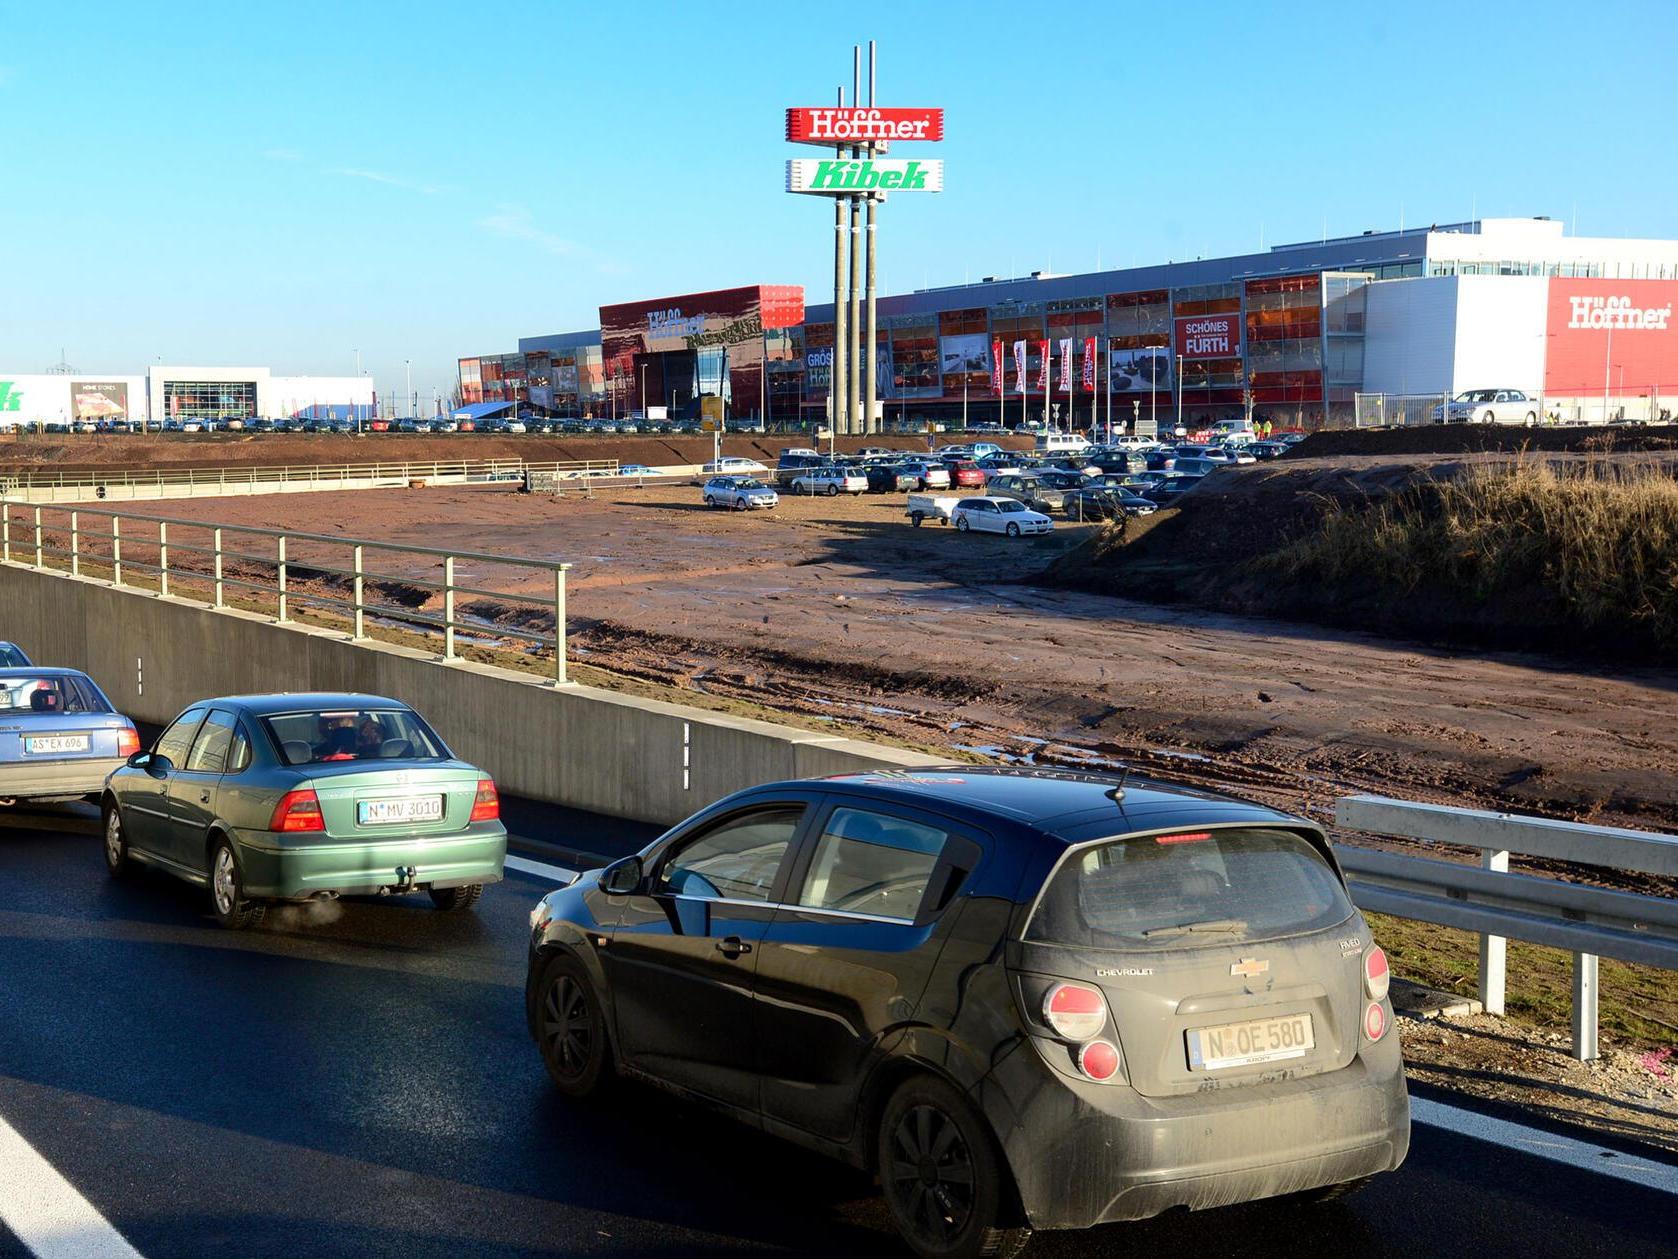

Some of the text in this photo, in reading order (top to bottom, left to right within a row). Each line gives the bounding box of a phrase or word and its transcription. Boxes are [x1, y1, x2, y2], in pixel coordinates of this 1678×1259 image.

[808, 110, 930, 139] Höffner
[809, 161, 929, 189] Kibek
[1568, 295, 1671, 330] Höffner
[1185, 320, 1229, 335] SCHÖNES
[1185, 334, 1229, 354] FÜRTH
[369, 801, 440, 818] N MV 3010
[1095, 968, 1153, 977] CHEVROLET
[1208, 1031, 1224, 1059] N
[1237, 1025, 1266, 1056] OE
[1267, 1020, 1306, 1050] 580
